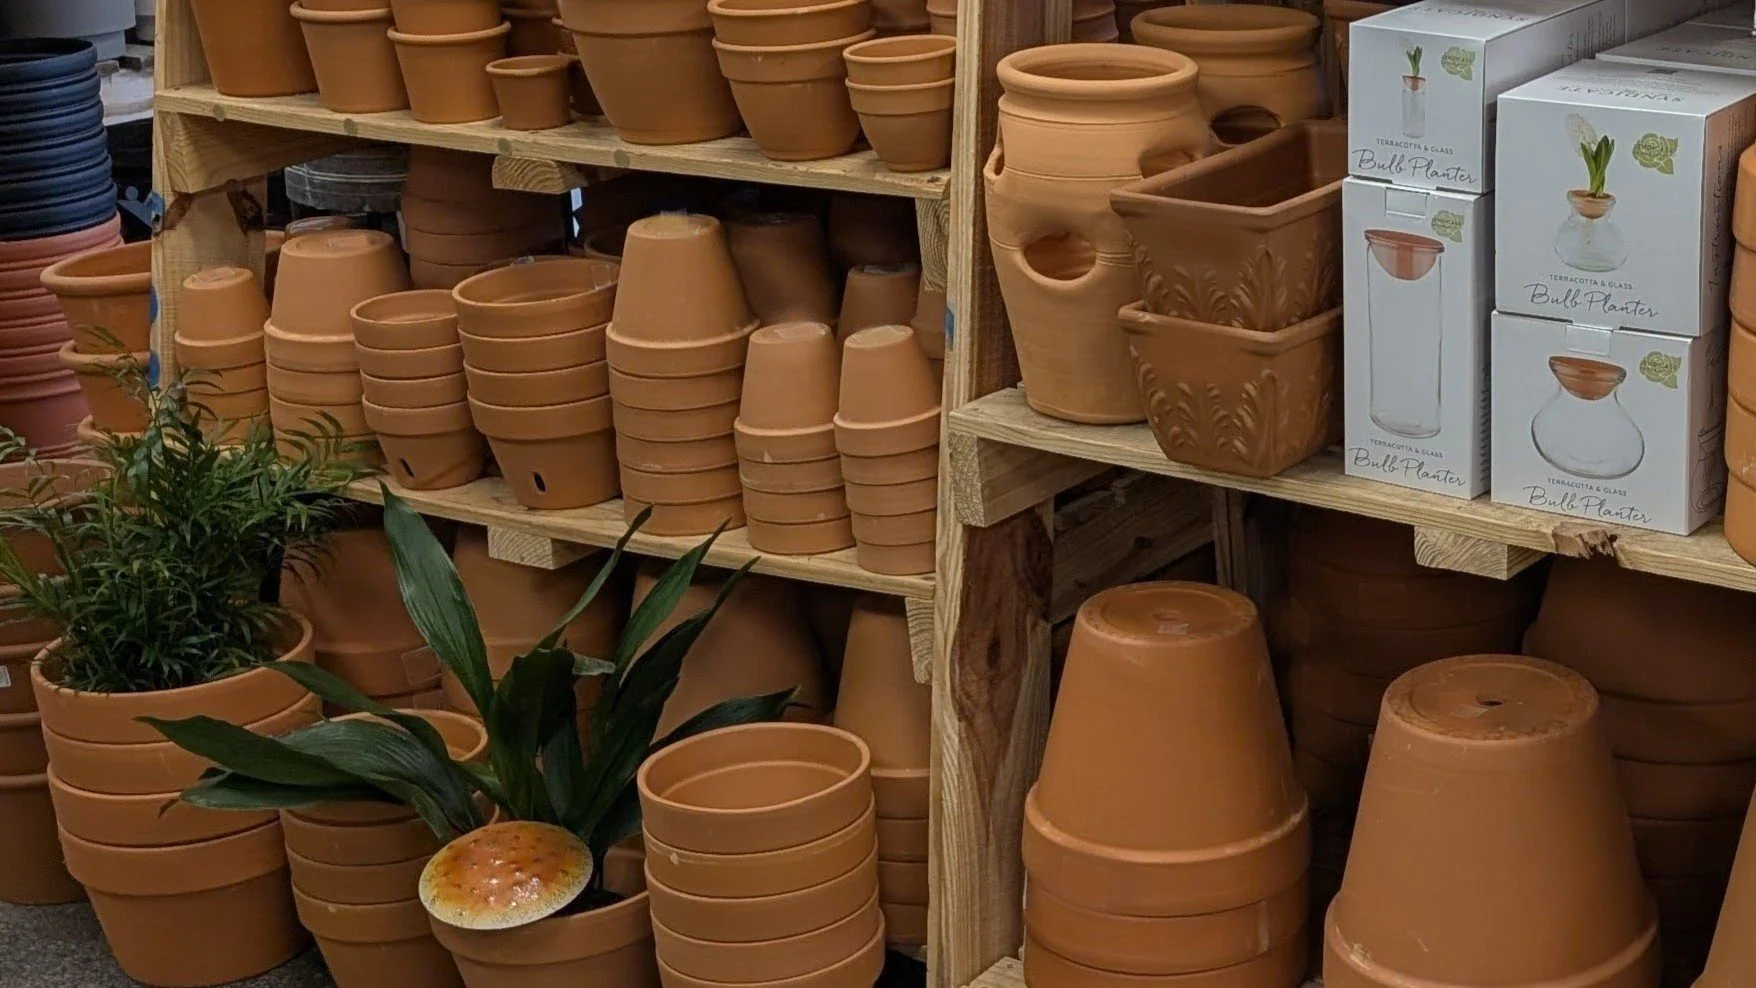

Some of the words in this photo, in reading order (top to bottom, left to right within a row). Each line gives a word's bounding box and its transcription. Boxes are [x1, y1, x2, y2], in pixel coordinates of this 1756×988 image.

[1376, 138, 1421, 151] TERRACOTTA
[1431, 146, 1453, 155] GLASS
[1352, 149, 1405, 175] Bulb
[1408, 156, 1478, 184] Planter
[1550, 274, 1598, 286] TERRACOTTA
[1608, 282, 1633, 290] GLASS
[1524, 283, 1582, 309] Bulb
[1584, 290, 1658, 318] Planter
[1370, 438, 1413, 453] TERRACOTTA
[1421, 449, 1443, 459] GLASS
[1348, 447, 1399, 473] Bulb
[1400, 457, 1466, 487] Planter
[1548, 477, 1593, 490] TERRACOTTA
[1603, 488, 1627, 497] GLASS
[1523, 485, 1579, 512] Bulb
[1580, 495, 1652, 524] Planter
